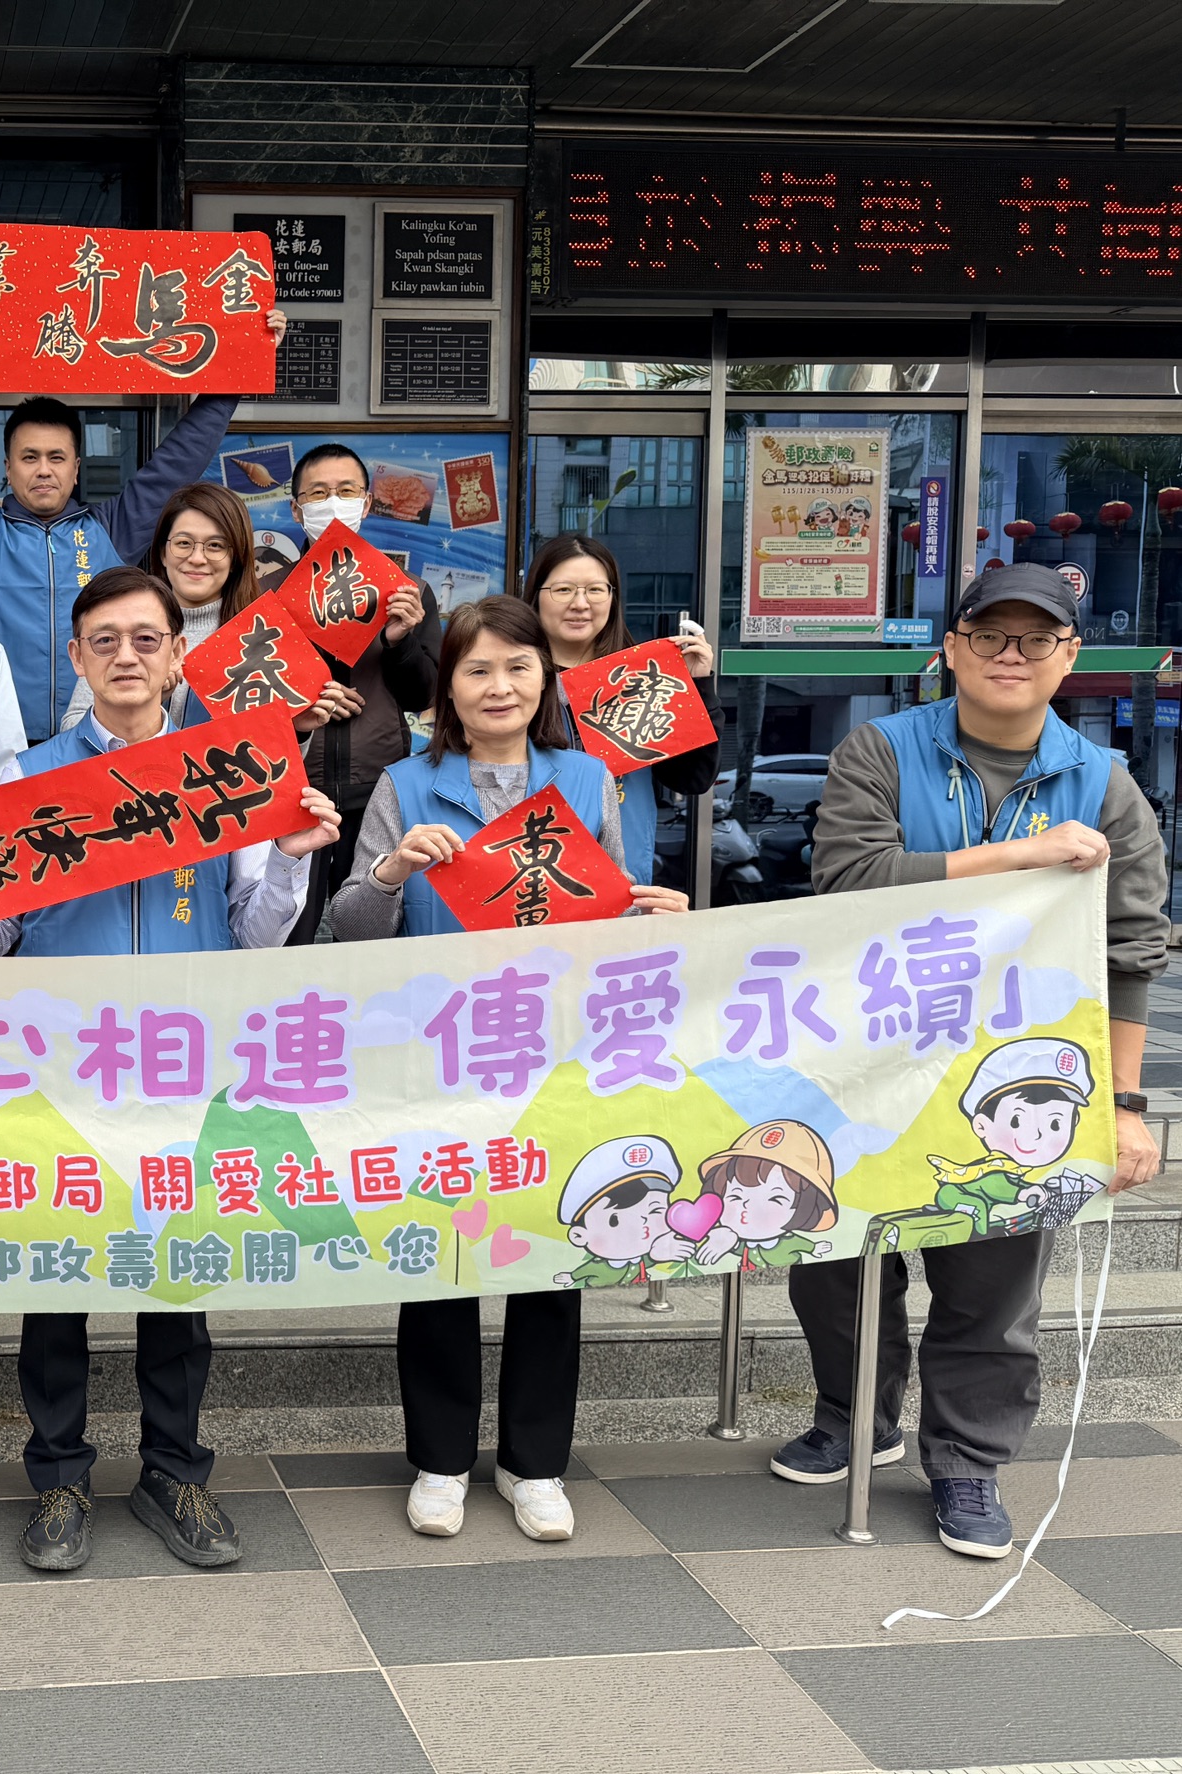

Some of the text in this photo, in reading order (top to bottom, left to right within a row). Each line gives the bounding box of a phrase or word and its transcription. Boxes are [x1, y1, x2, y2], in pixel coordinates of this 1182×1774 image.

[275, 219, 306, 237] 花蓮
[401, 220, 446, 232] Kalingku
[423, 233, 456, 246] Yofing
[395, 249, 483, 262] Sapah pdsan patas
[543, 227, 551, 295] 8333507
[285, 271, 321, 283] Office
[403, 262, 474, 275] Kwan Skangki
[391, 281, 485, 294] Kilay pawkan iubin
[785, 444, 854, 464] 郵政壽險
[925, 497, 939, 574] 請脫安全帽再進入
[309, 546, 380, 629] 滿
[205, 613, 311, 714] 春
[423, 916, 1023, 1098] 傳愛永續」
[140, 1136, 547, 1214] 關愛社區活動
